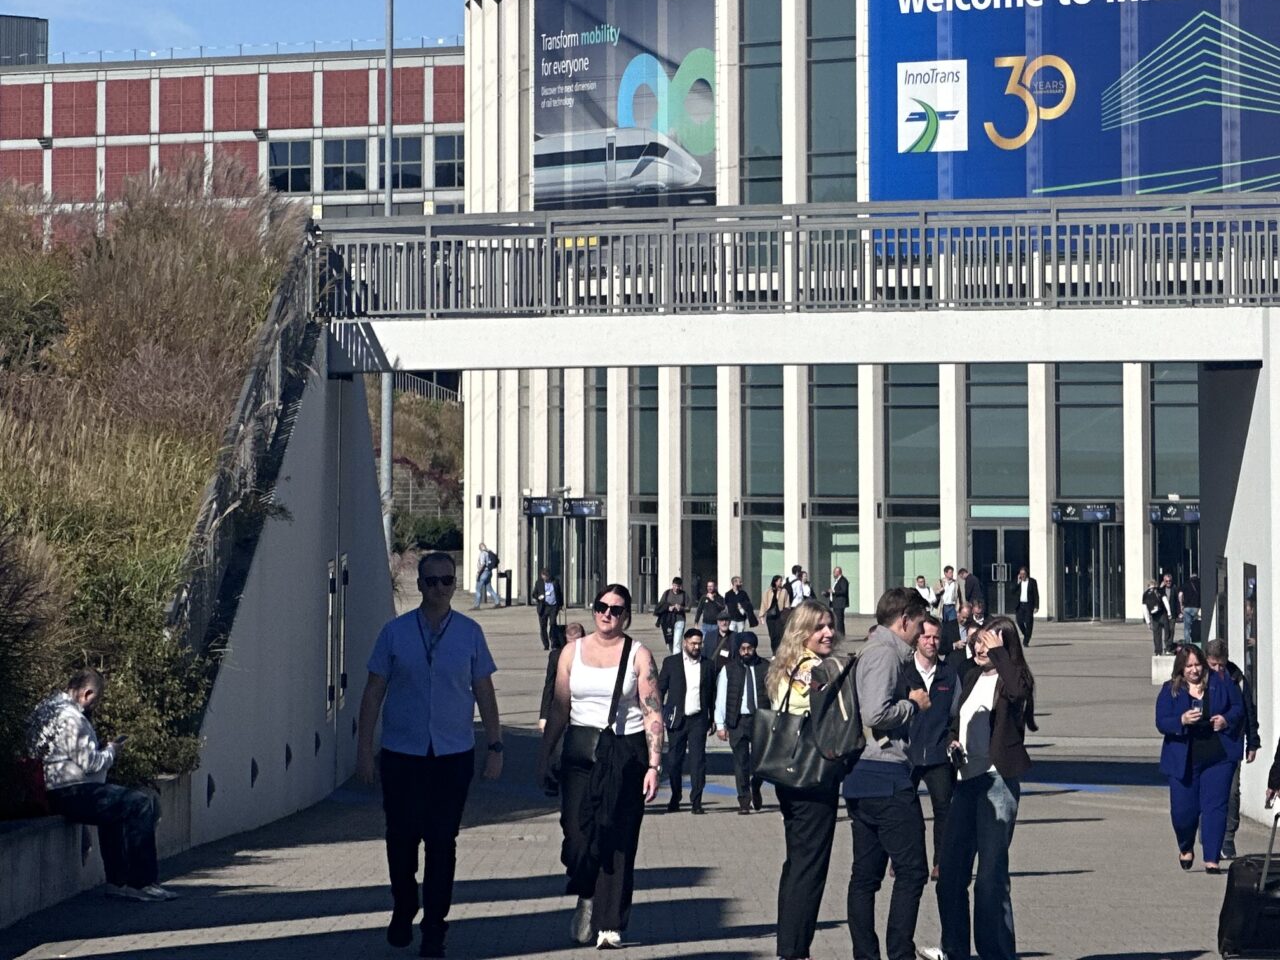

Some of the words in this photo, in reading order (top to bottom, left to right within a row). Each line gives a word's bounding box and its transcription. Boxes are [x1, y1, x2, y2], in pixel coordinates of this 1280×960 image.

[540, 29, 579, 51] Transform
[581, 24, 621, 47] mobility
[541, 59, 552, 76] for
[553, 57, 589, 77] everyone
[904, 68, 960, 85] InnoTrans
[1032, 80, 1064, 90] YEARS
